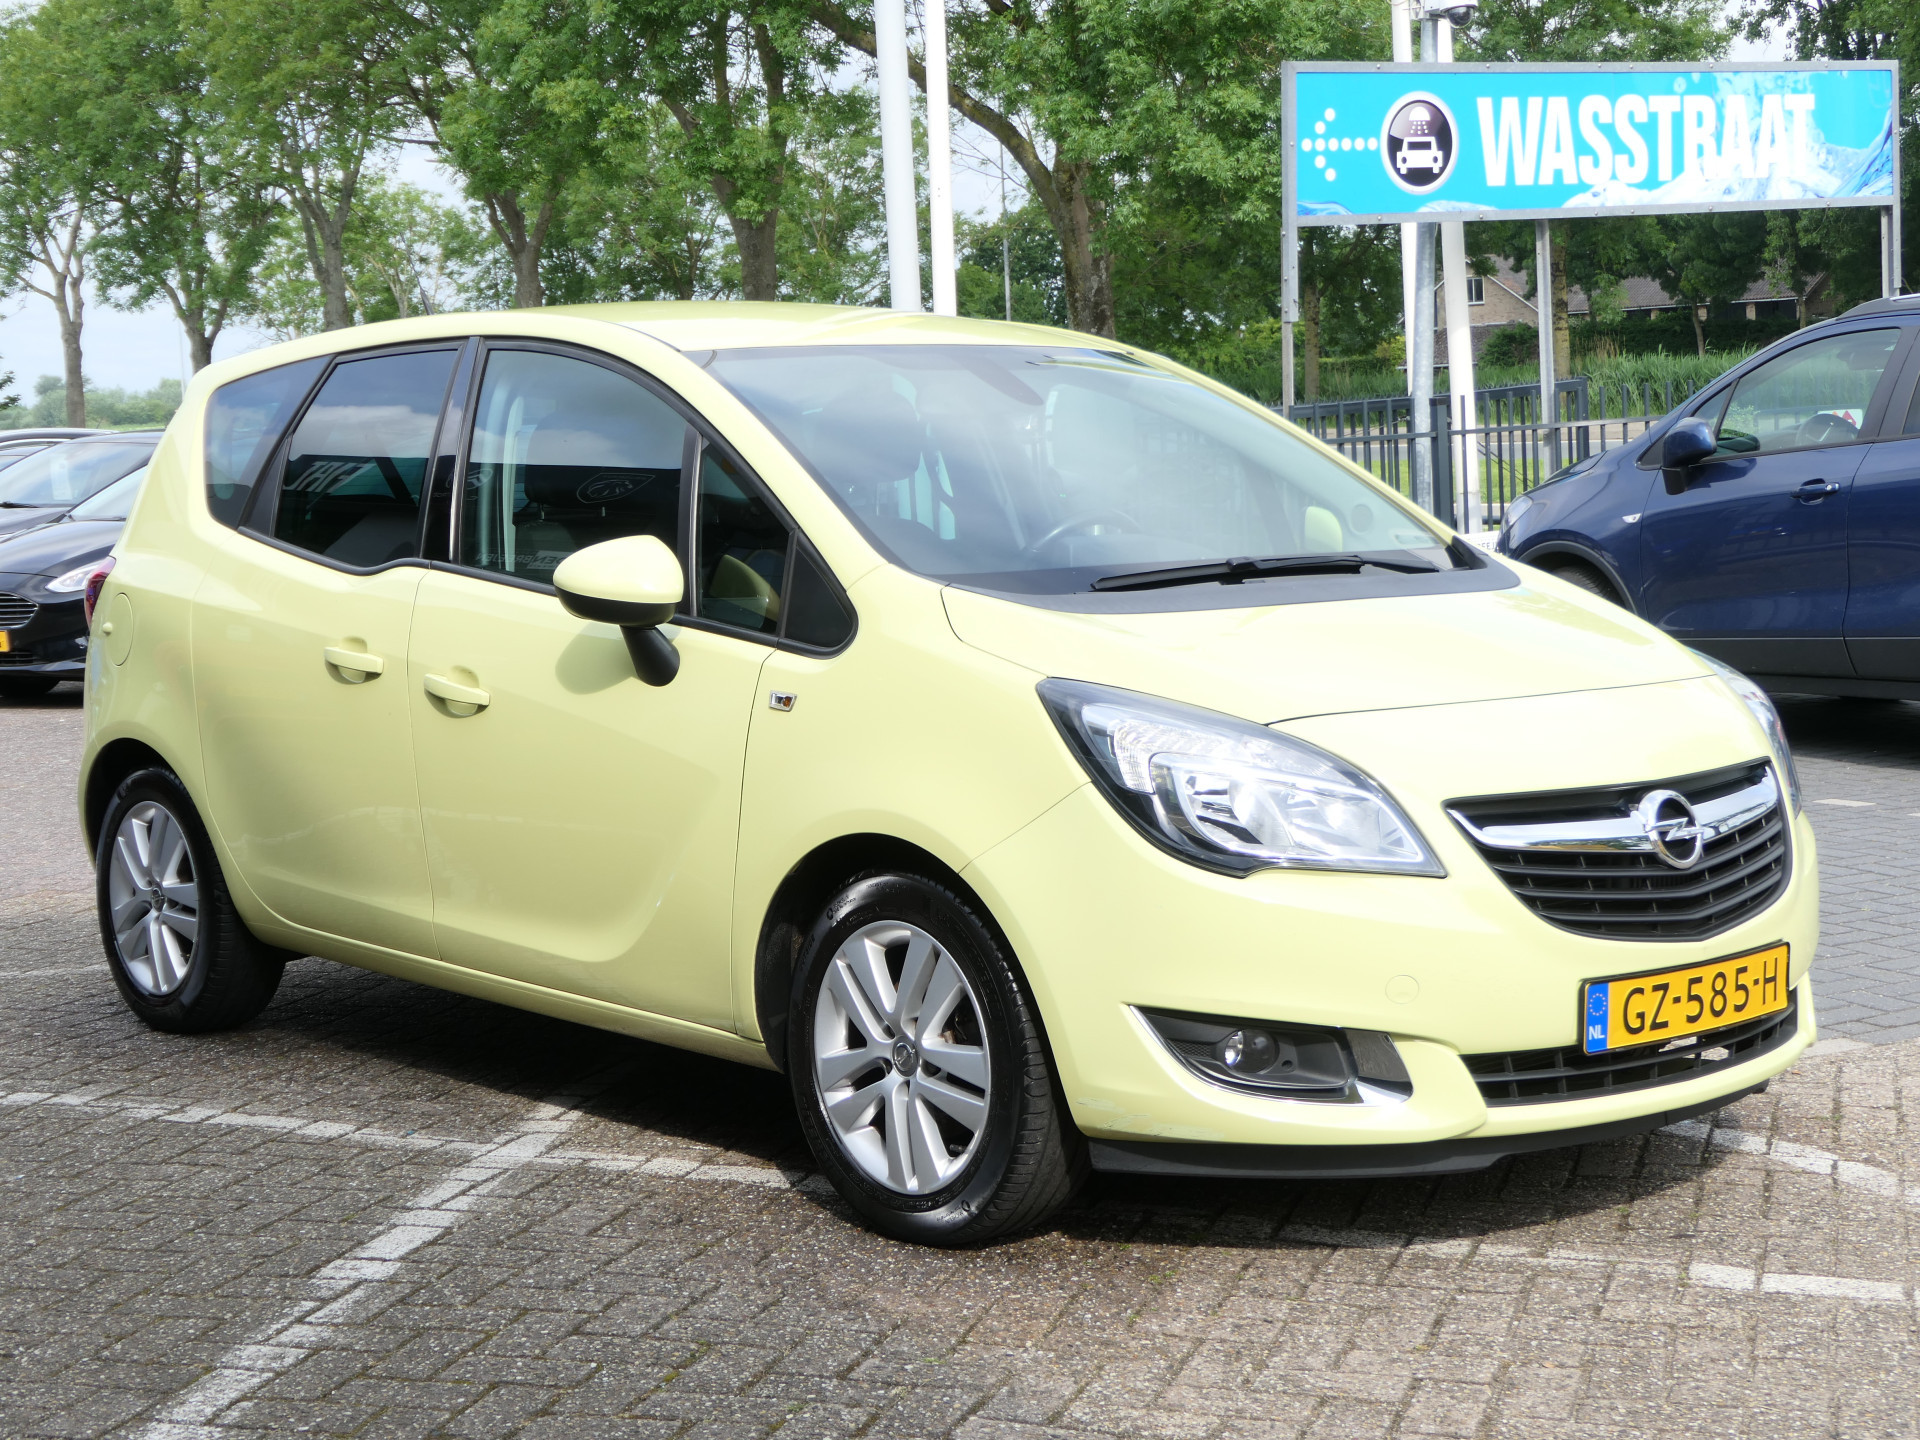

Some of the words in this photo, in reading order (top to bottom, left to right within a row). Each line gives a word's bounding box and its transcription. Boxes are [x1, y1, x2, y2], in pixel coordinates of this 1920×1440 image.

[1476, 92, 1816, 187] WASSTRAAT
[1588, 1025, 1605, 1040] NL
[1622, 957, 1778, 1035] GZ-585-H
